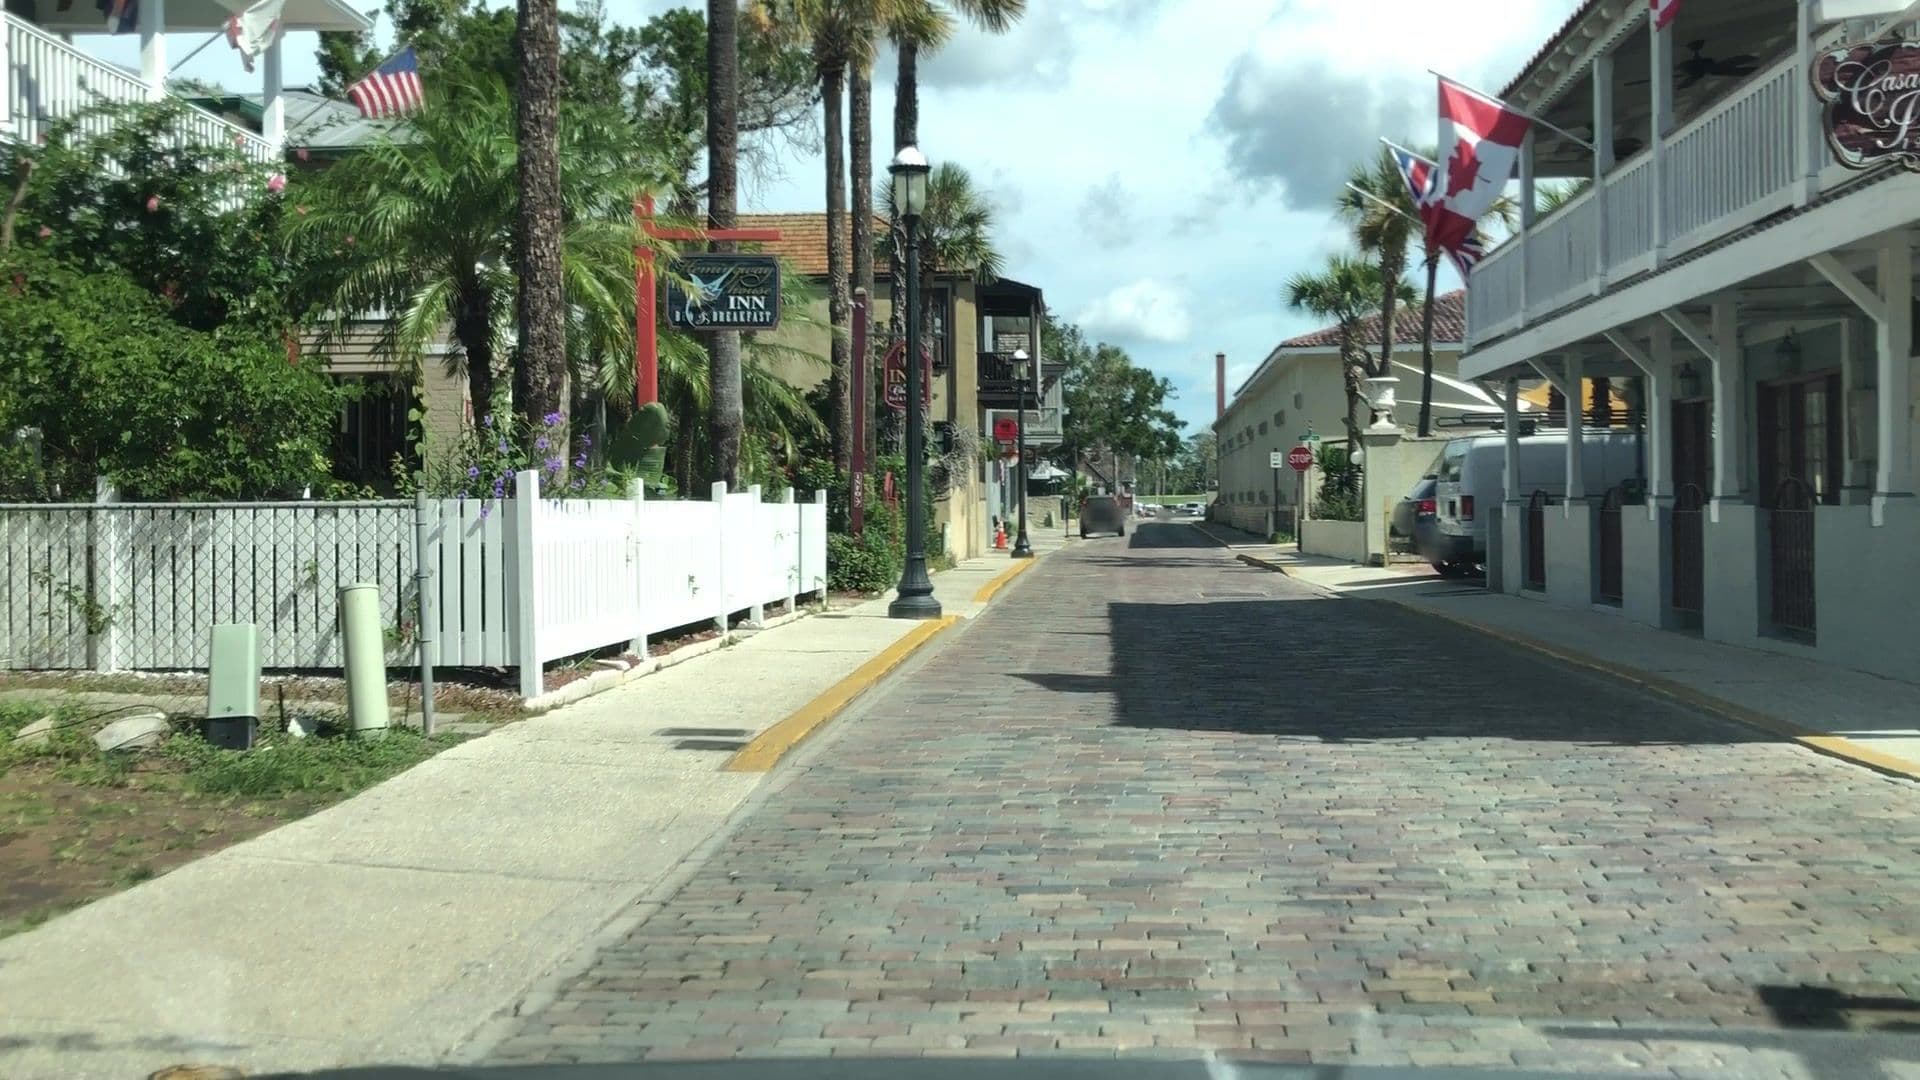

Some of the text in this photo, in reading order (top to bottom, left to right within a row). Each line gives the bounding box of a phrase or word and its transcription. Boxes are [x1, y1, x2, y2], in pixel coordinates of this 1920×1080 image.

[1834, 60, 1920, 128] Casa
[728, 295, 766, 310] INN
[713, 310, 772, 323] BREAKFAST
[1289, 454, 1312, 464] STOP
